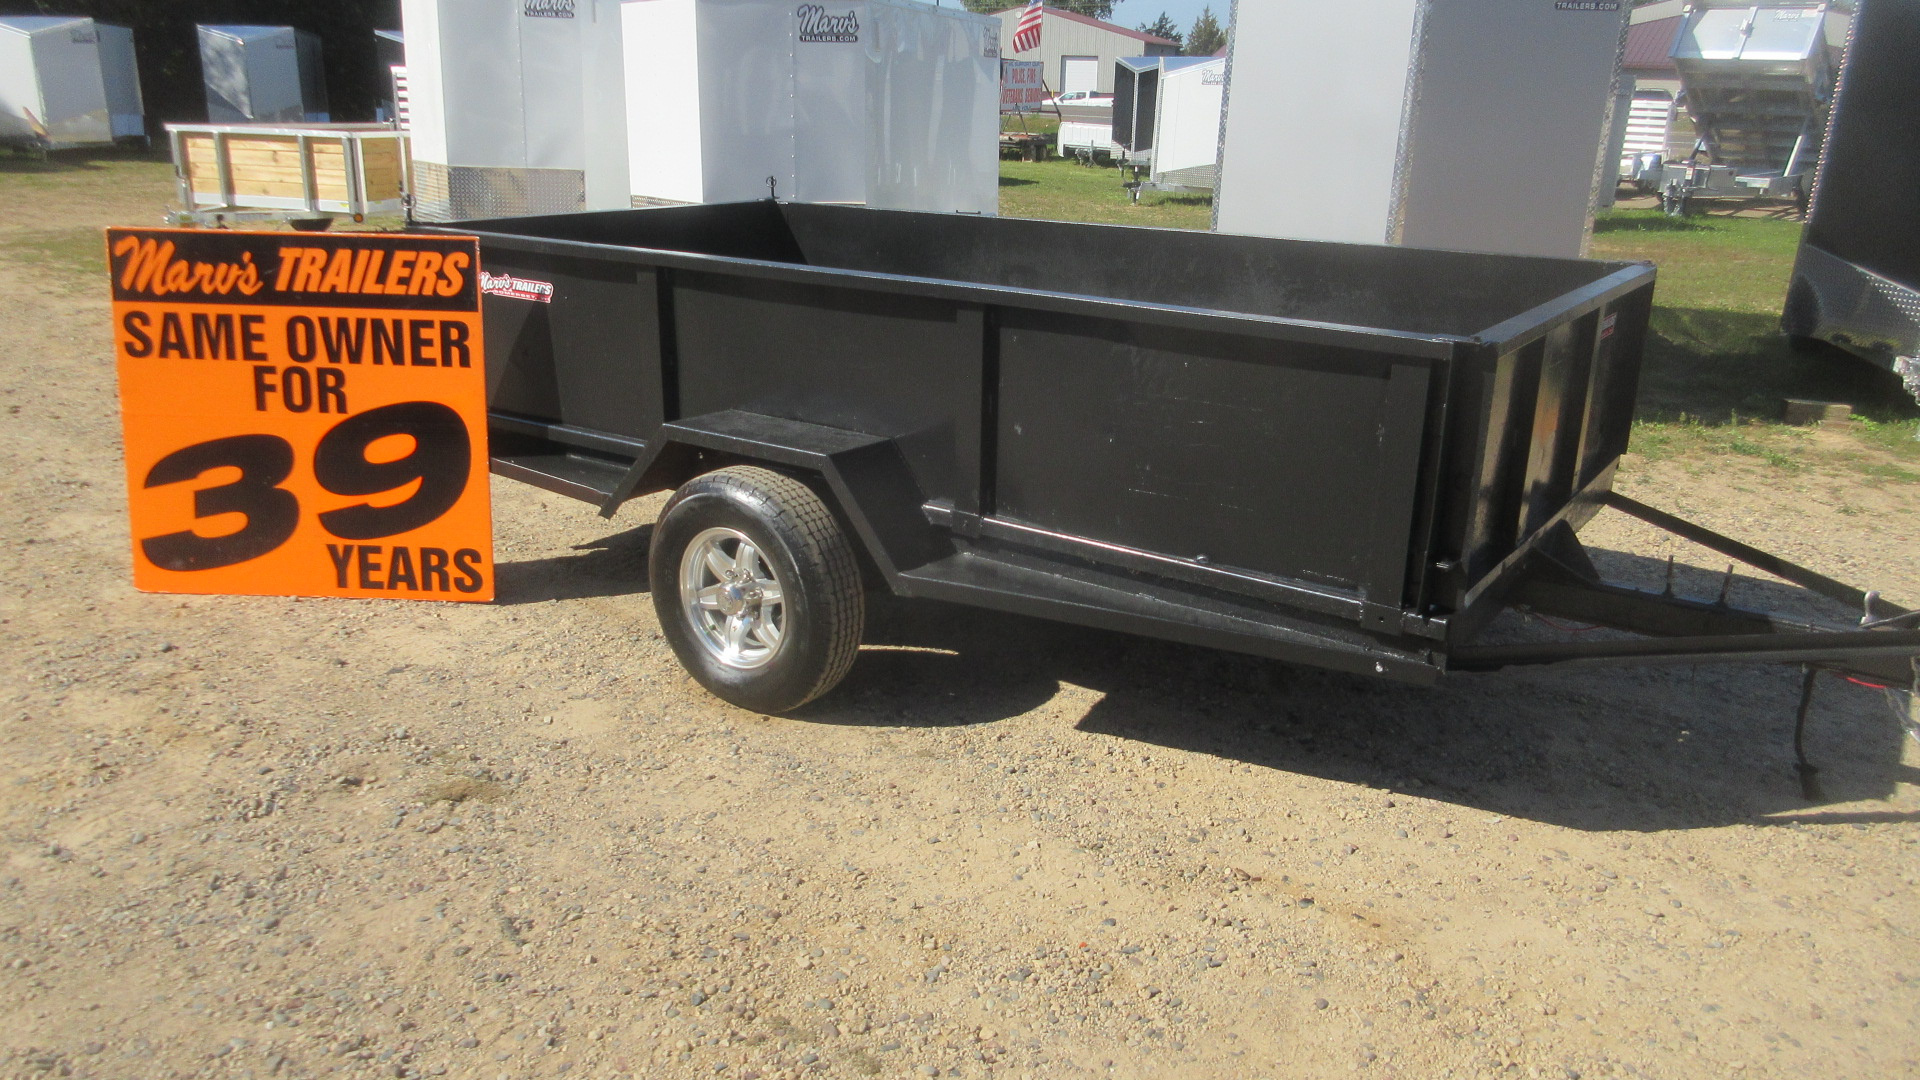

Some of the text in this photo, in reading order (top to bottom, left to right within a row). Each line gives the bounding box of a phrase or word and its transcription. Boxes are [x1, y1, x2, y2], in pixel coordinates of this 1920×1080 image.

[525, 0, 575, 11] arvs
[798, 4, 859, 34] Marv's
[1556, 2, 1619, 11] TRAILERS.COM
[114, 235, 471, 297] Marv's TRAILERS
[123, 311, 471, 368] SAME OWNER
[253, 365, 348, 414] FOR
[141, 400, 472, 572] 39
[326, 543, 483, 593] YEARS
